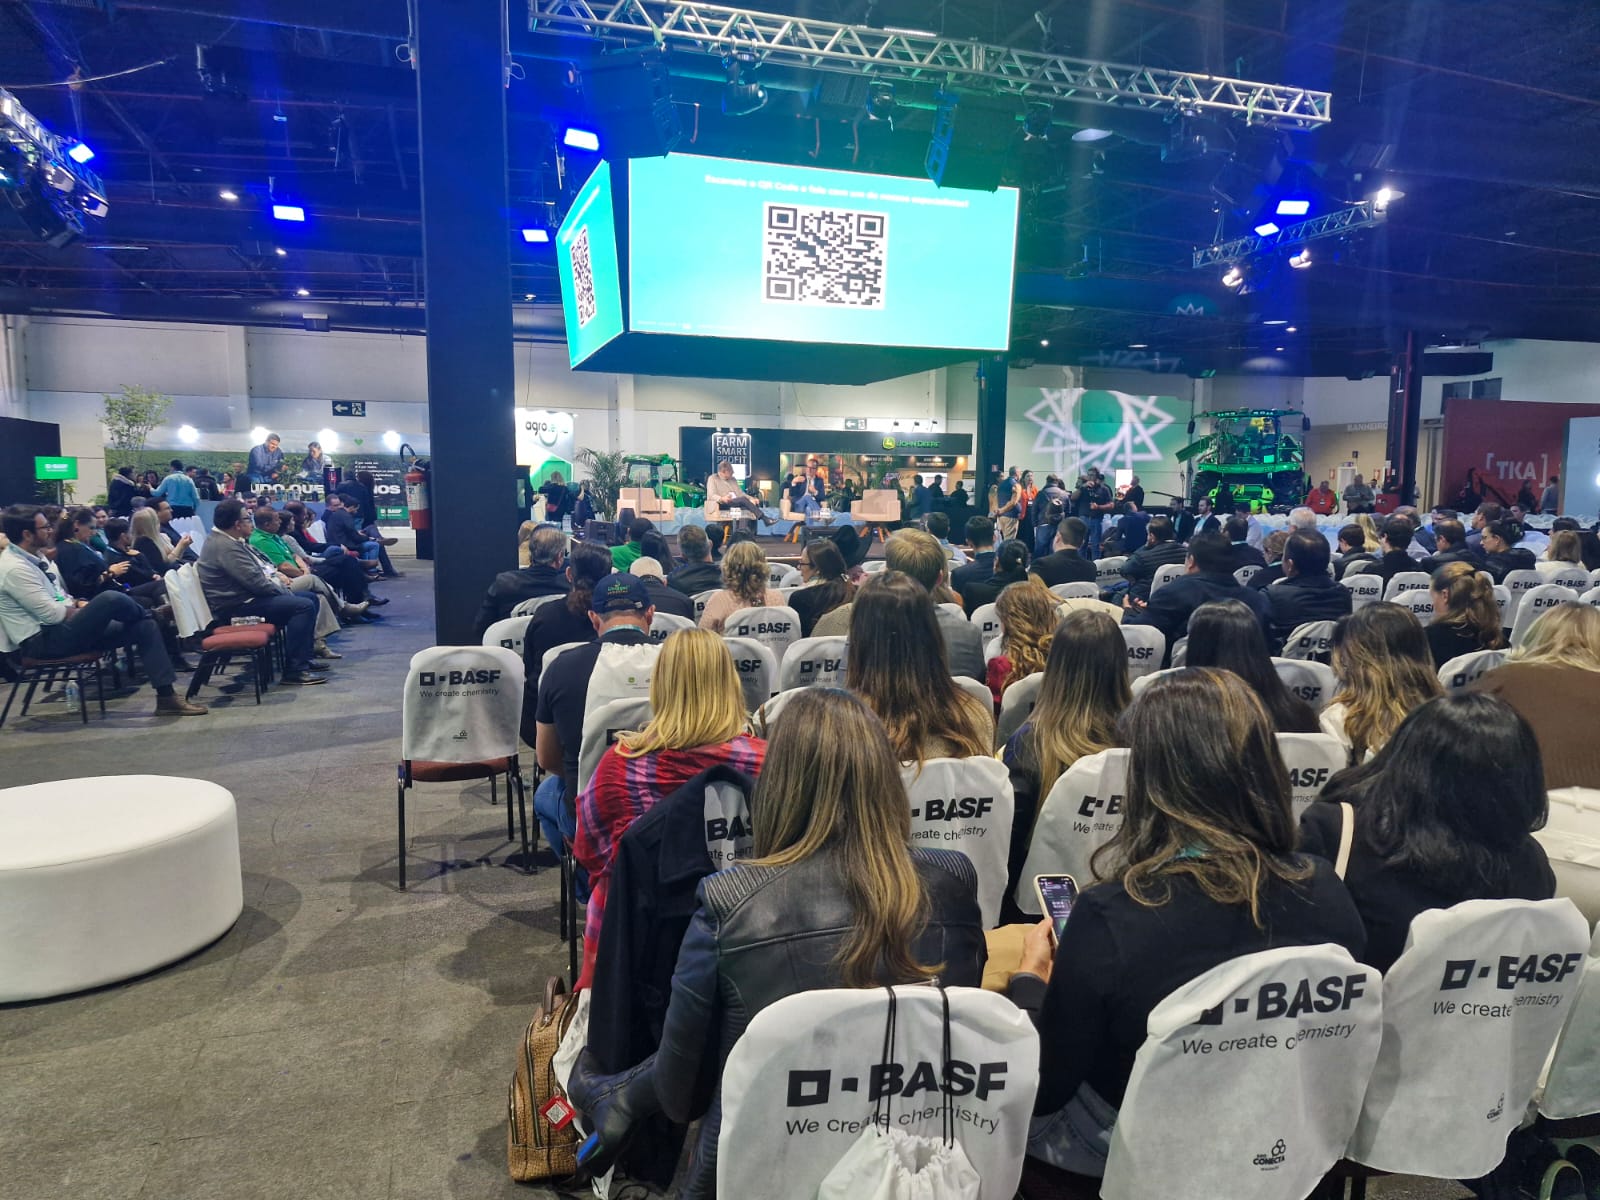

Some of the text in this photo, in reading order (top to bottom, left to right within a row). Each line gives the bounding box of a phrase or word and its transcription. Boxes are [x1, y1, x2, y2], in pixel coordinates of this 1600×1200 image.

[716, 436, 747, 447] FARM
[716, 447, 747, 456] SMART
[716, 456, 747, 464] PROFIT
[758, 622, 791, 634] BASF
[1128, 647, 1154, 660] ASF
[449, 669, 502, 686] BASF
[420, 687, 500, 698] We create chemistry
[1290, 767, 1329, 788] ASF
[925, 797, 994, 822] BASF
[912, 828, 940, 840] reate
[1256, 973, 1367, 1021] BASF
[1433, 1000, 1456, 1015] We
[1182, 1039, 1213, 1054] We
[1218, 1032, 1278, 1052] create
[868, 1060, 1009, 1103] BASF
[786, 1118, 820, 1136] We
